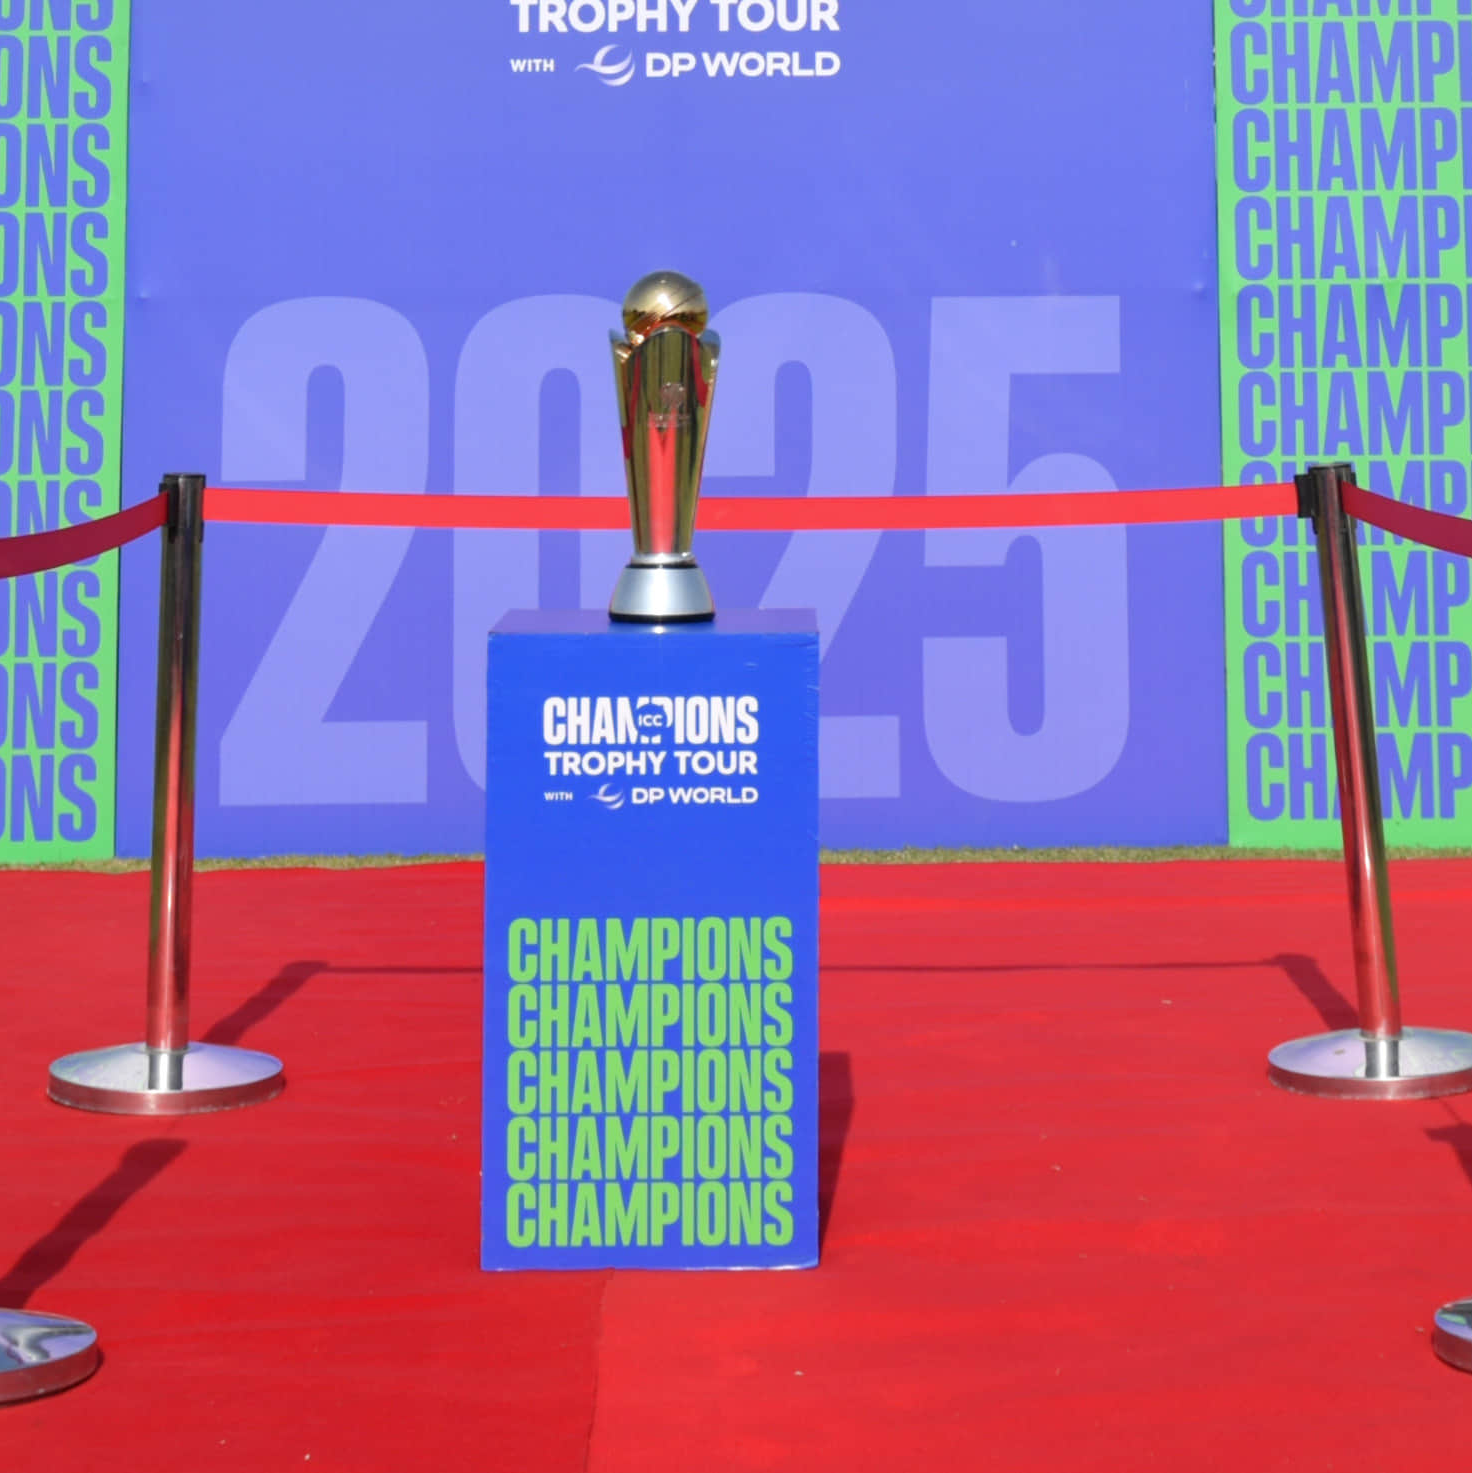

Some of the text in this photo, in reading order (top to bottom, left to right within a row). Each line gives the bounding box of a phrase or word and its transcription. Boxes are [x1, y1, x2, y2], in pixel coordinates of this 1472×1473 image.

[510, 51, 842, 78] WITH DP WORLD
[543, 695, 760, 746] CHAMPIONS
[638, 714, 663, 727] ICC
[543, 750, 759, 776] TROPHY TOUR
[544, 786, 759, 804] WITH DP WORLD
[509, 916, 793, 983] CHAMPIONS
[508, 981, 793, 1049] CHAMPIONS
[508, 1048, 794, 1115] CHAMPIONS
[507, 1114, 794, 1181] CHAMPIONS
[507, 1180, 794, 1247] CHAMPIONS
